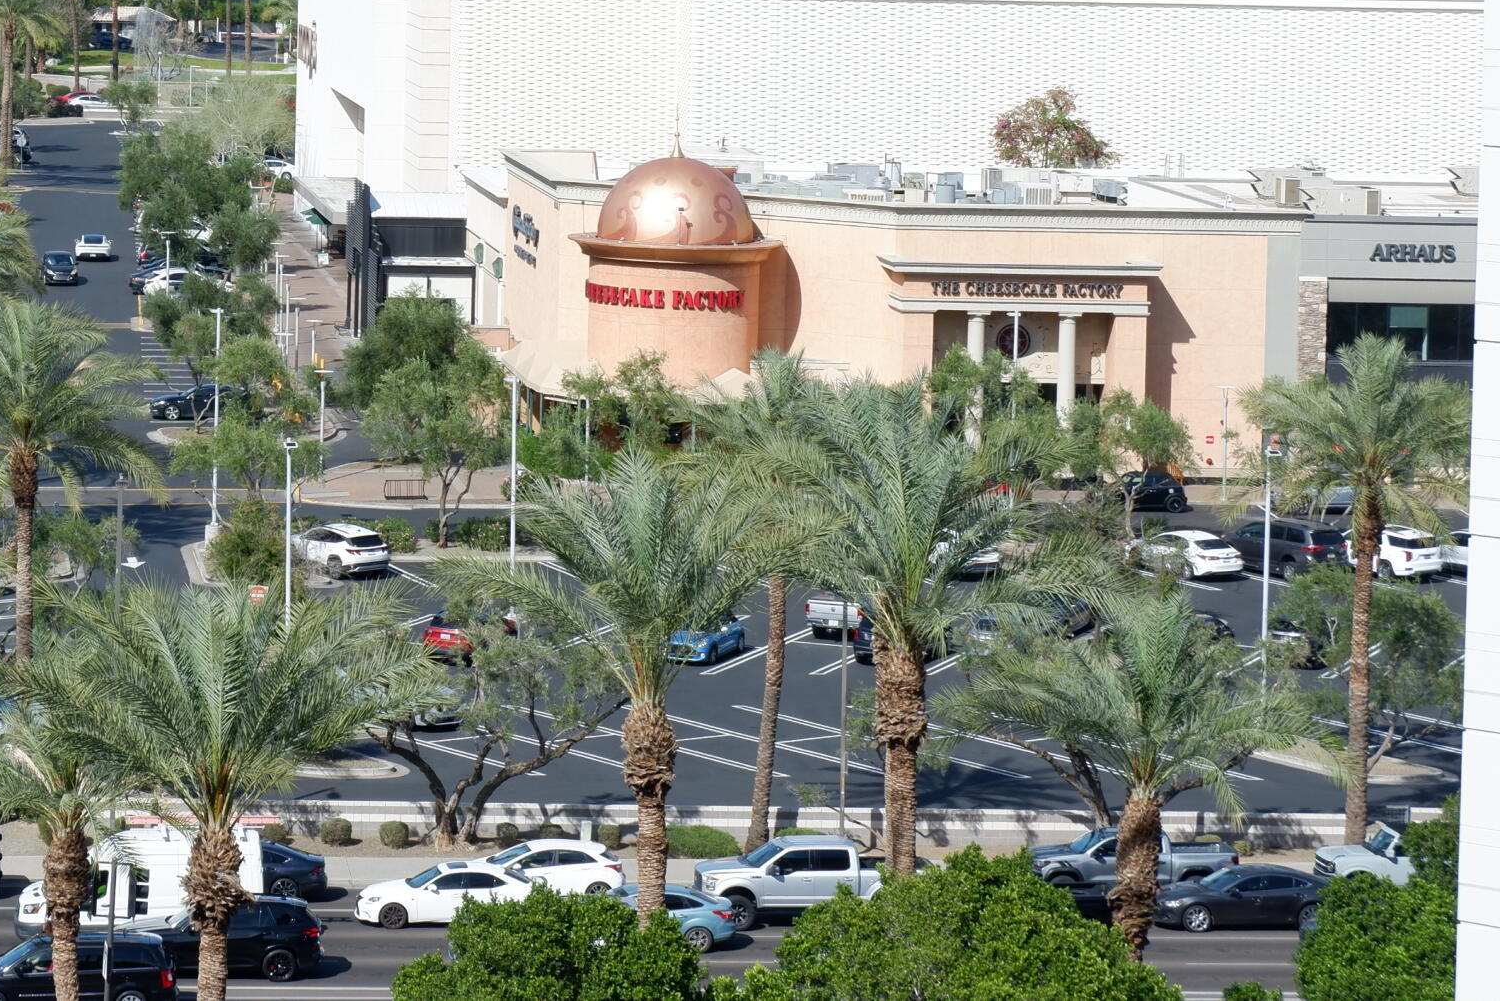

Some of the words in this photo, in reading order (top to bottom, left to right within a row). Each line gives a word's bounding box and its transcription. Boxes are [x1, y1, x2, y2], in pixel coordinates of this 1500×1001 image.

[1369, 243, 1457, 263] ARHAUS
[672, 289, 746, 312] FACTORY
[931, 281, 961, 297] THE
[965, 281, 1058, 298] CHEESECAKE
[1062, 282, 1125, 300] FACTORY
